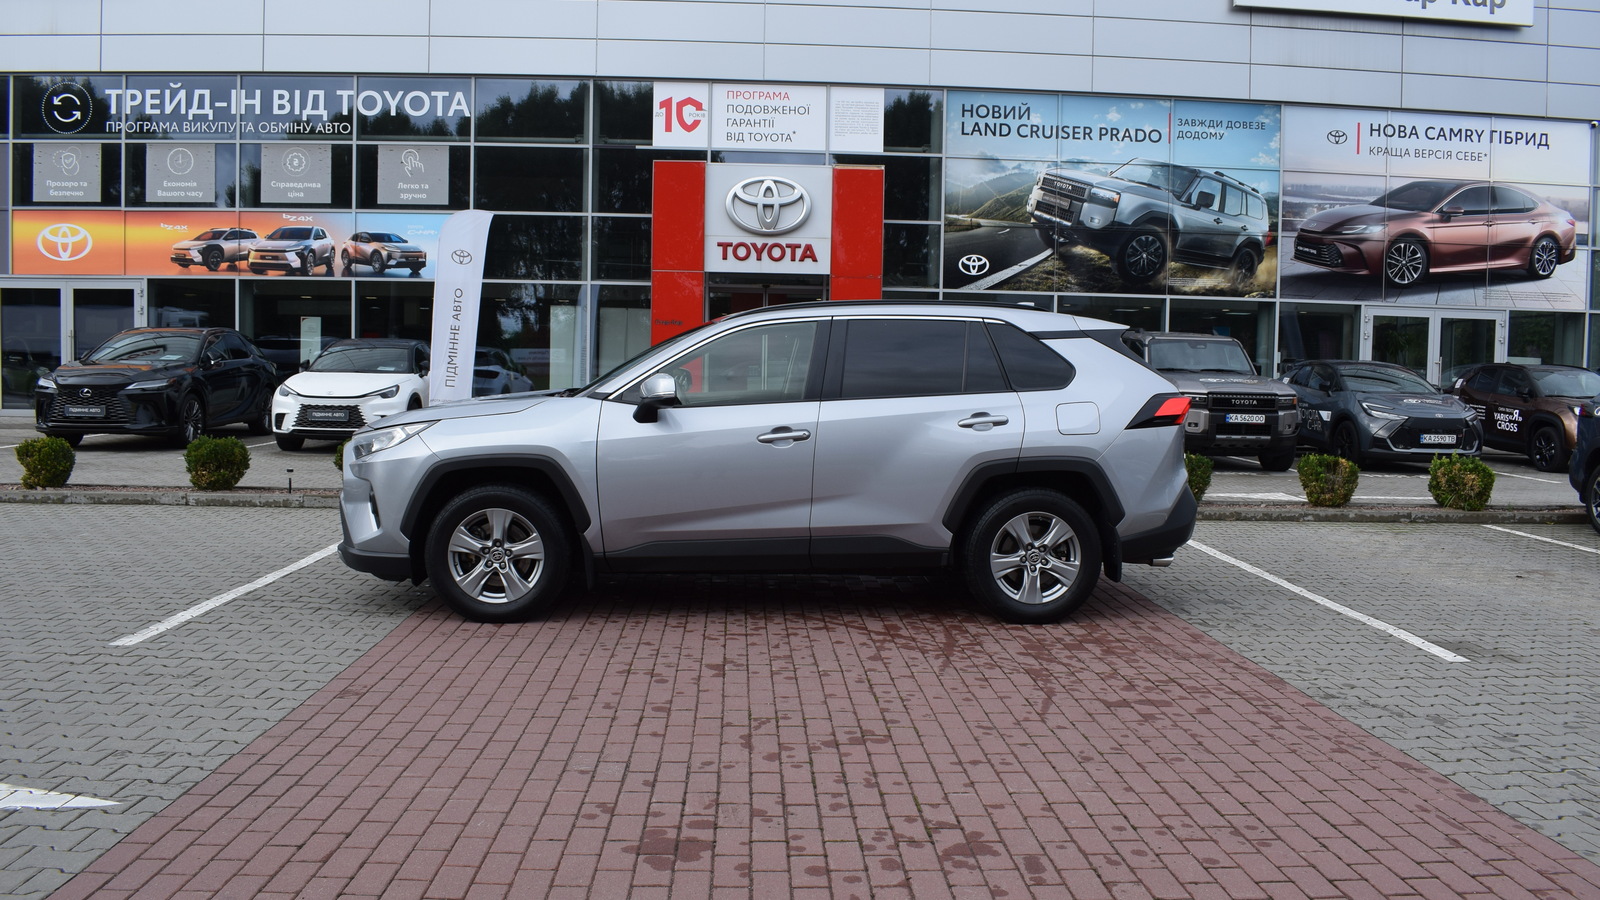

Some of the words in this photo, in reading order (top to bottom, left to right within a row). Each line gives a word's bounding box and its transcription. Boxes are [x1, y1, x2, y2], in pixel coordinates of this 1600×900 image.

[105, 82, 261, 121] ТРЕЙД-ІН
[272, 89, 328, 121] ВІД
[336, 90, 471, 117] TOYOTA
[726, 90, 790, 101] ПРОГРАМА
[726, 104, 811, 116] ПОДОВЖЕНОЇ
[961, 102, 1031, 121] НОВИЙ
[106, 121, 179, 133] ПРОГРАМА
[183, 122, 236, 133] ВИКУПУ
[240, 122, 255, 133] ТА
[258, 122, 313, 133] ОБМІНУ
[315, 122, 351, 134] АВТО
[726, 117, 776, 128] ГАРАНТІЇ
[1177, 118, 1223, 129] ЗАВЖДИ
[1225, 120, 1266, 131] ДОВЕЗЕ
[726, 131, 745, 143] ВІД
[961, 121, 1011, 137] LAND
[1016, 124, 1093, 141] CRUISER
[1098, 127, 1162, 143] PRADO
[1176, 130, 1225, 141] ДОДОМУ
[1369, 123, 1420, 139] НОВА
[1425, 126, 1485, 143] CAMRY
[1489, 129, 1550, 150] ГІБРИД
[1369, 146, 1411, 158] КРАЩА
[1414, 148, 1453, 160] ВЕРСІЯ
[46, 180, 77, 190] Прозоро
[163, 180, 197, 188] Економія
[271, 180, 321, 190] Справедлива
[397, 182, 418, 190] Легко
[49, 189, 84, 197] безпечно
[157, 189, 186, 197] Вашого
[287, 190, 304, 199] ціна
[400, 192, 427, 200] зручно
[716, 241, 818, 263] TOYOTA
[452, 287, 464, 321] АВТО
[445, 324, 460, 388] ПІДМІННЕ
[1494, 412, 1509, 421] YARIS
[1496, 420, 1518, 432] CROSS
